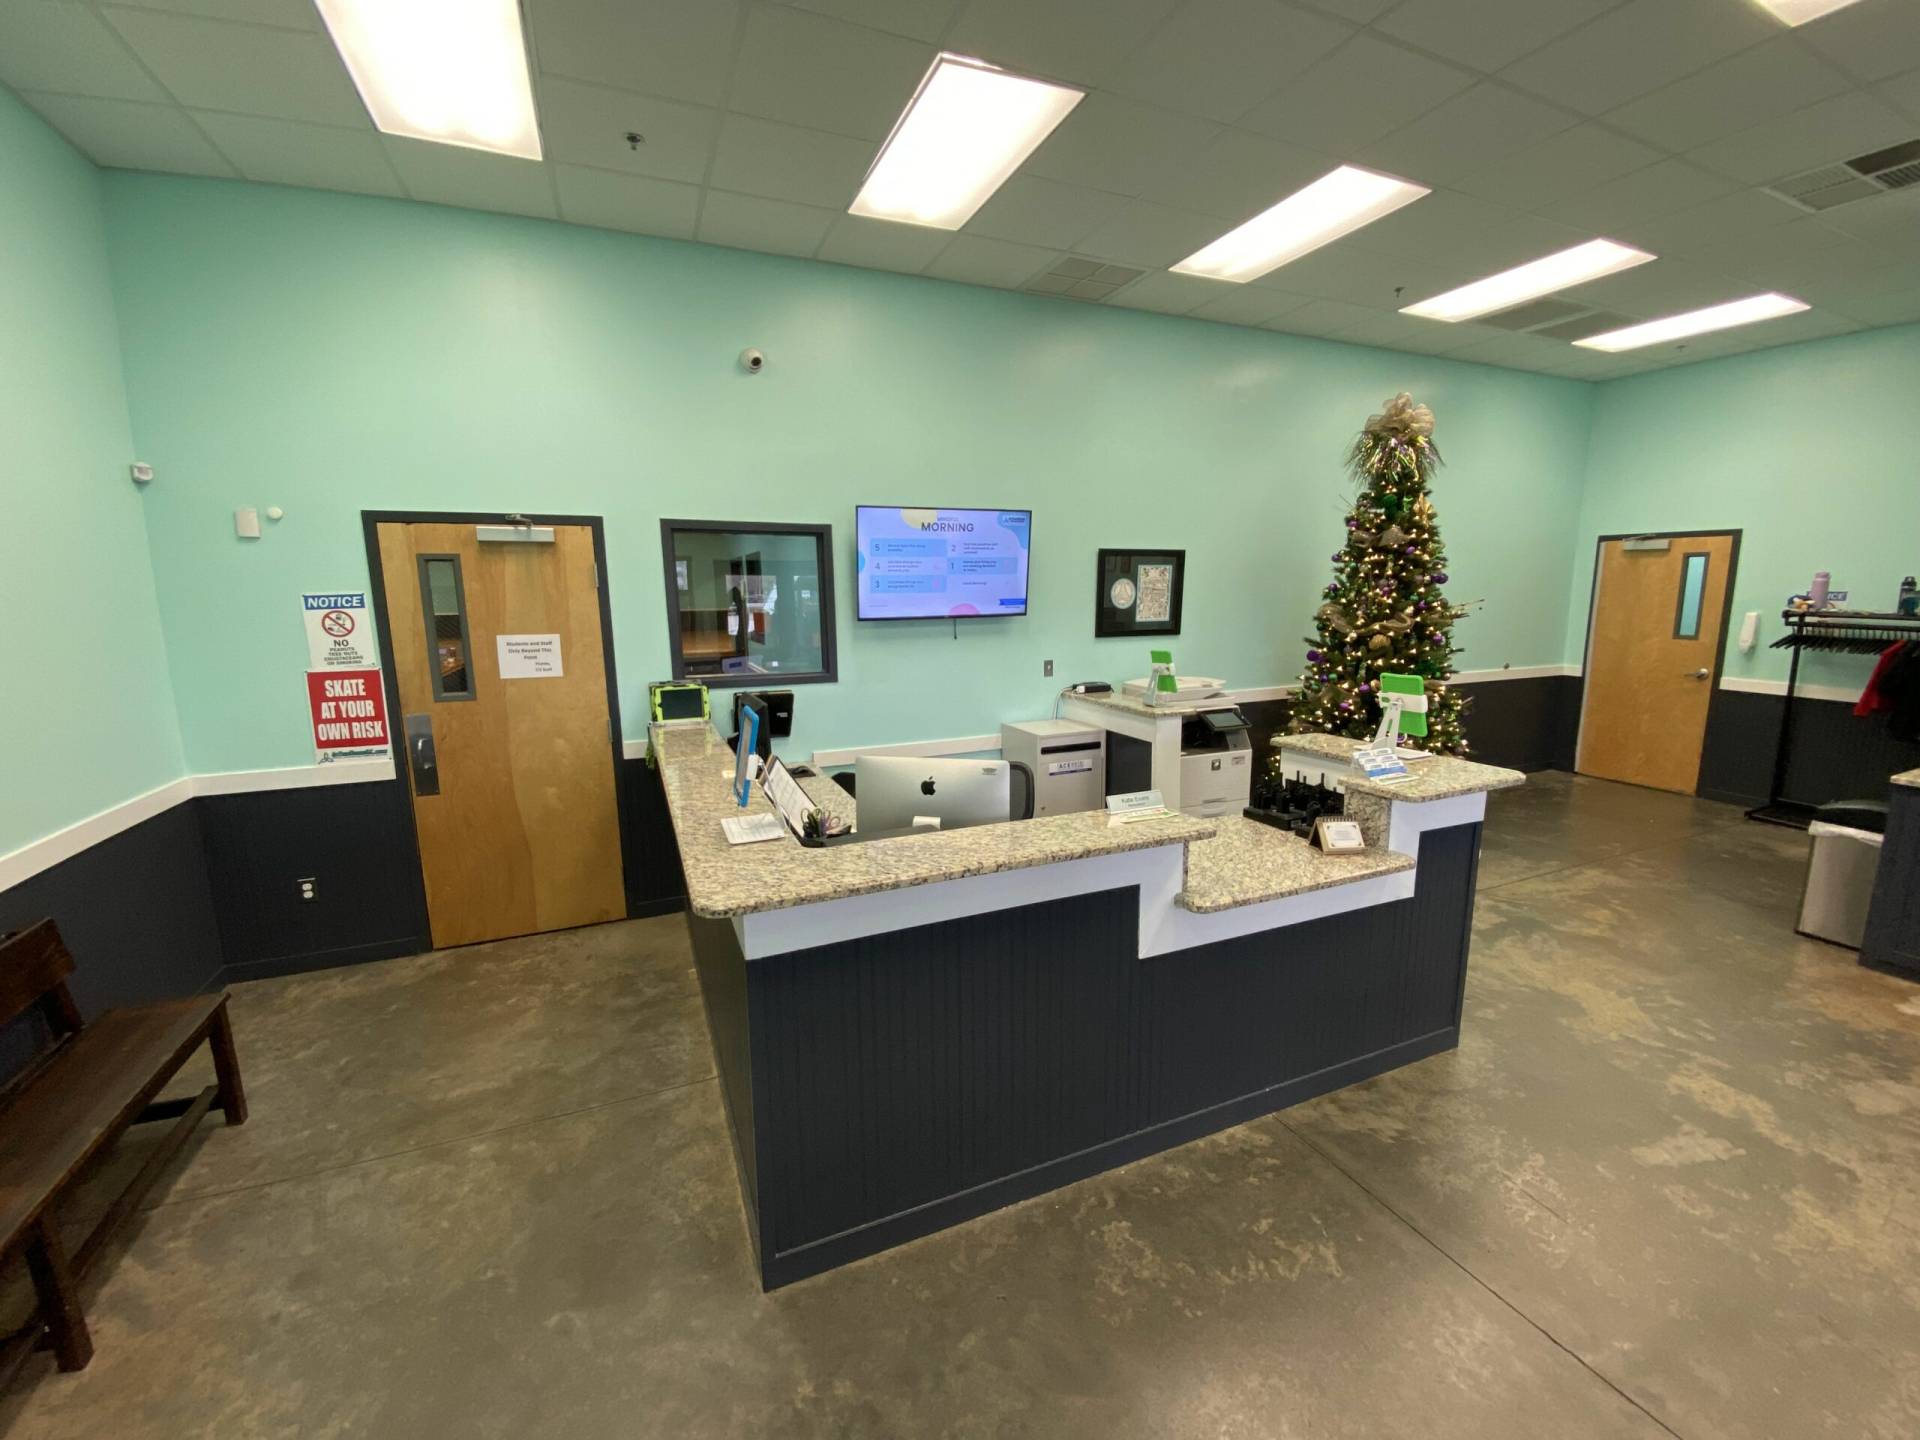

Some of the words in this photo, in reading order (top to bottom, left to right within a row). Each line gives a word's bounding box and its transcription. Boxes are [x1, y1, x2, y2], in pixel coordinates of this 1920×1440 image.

[921, 522, 975, 532] MORNING
[874, 543, 880, 552] 5
[951, 544, 956, 552] 2
[874, 562, 880, 570] 4
[307, 596, 362, 608] NOTICE
[333, 639, 349, 647] NO
[324, 678, 366, 698] SKATE
[321, 701, 337, 719] AT
[339, 699, 376, 718] YOUR
[317, 722, 350, 741] OWN
[351, 720, 384, 739] RISK
